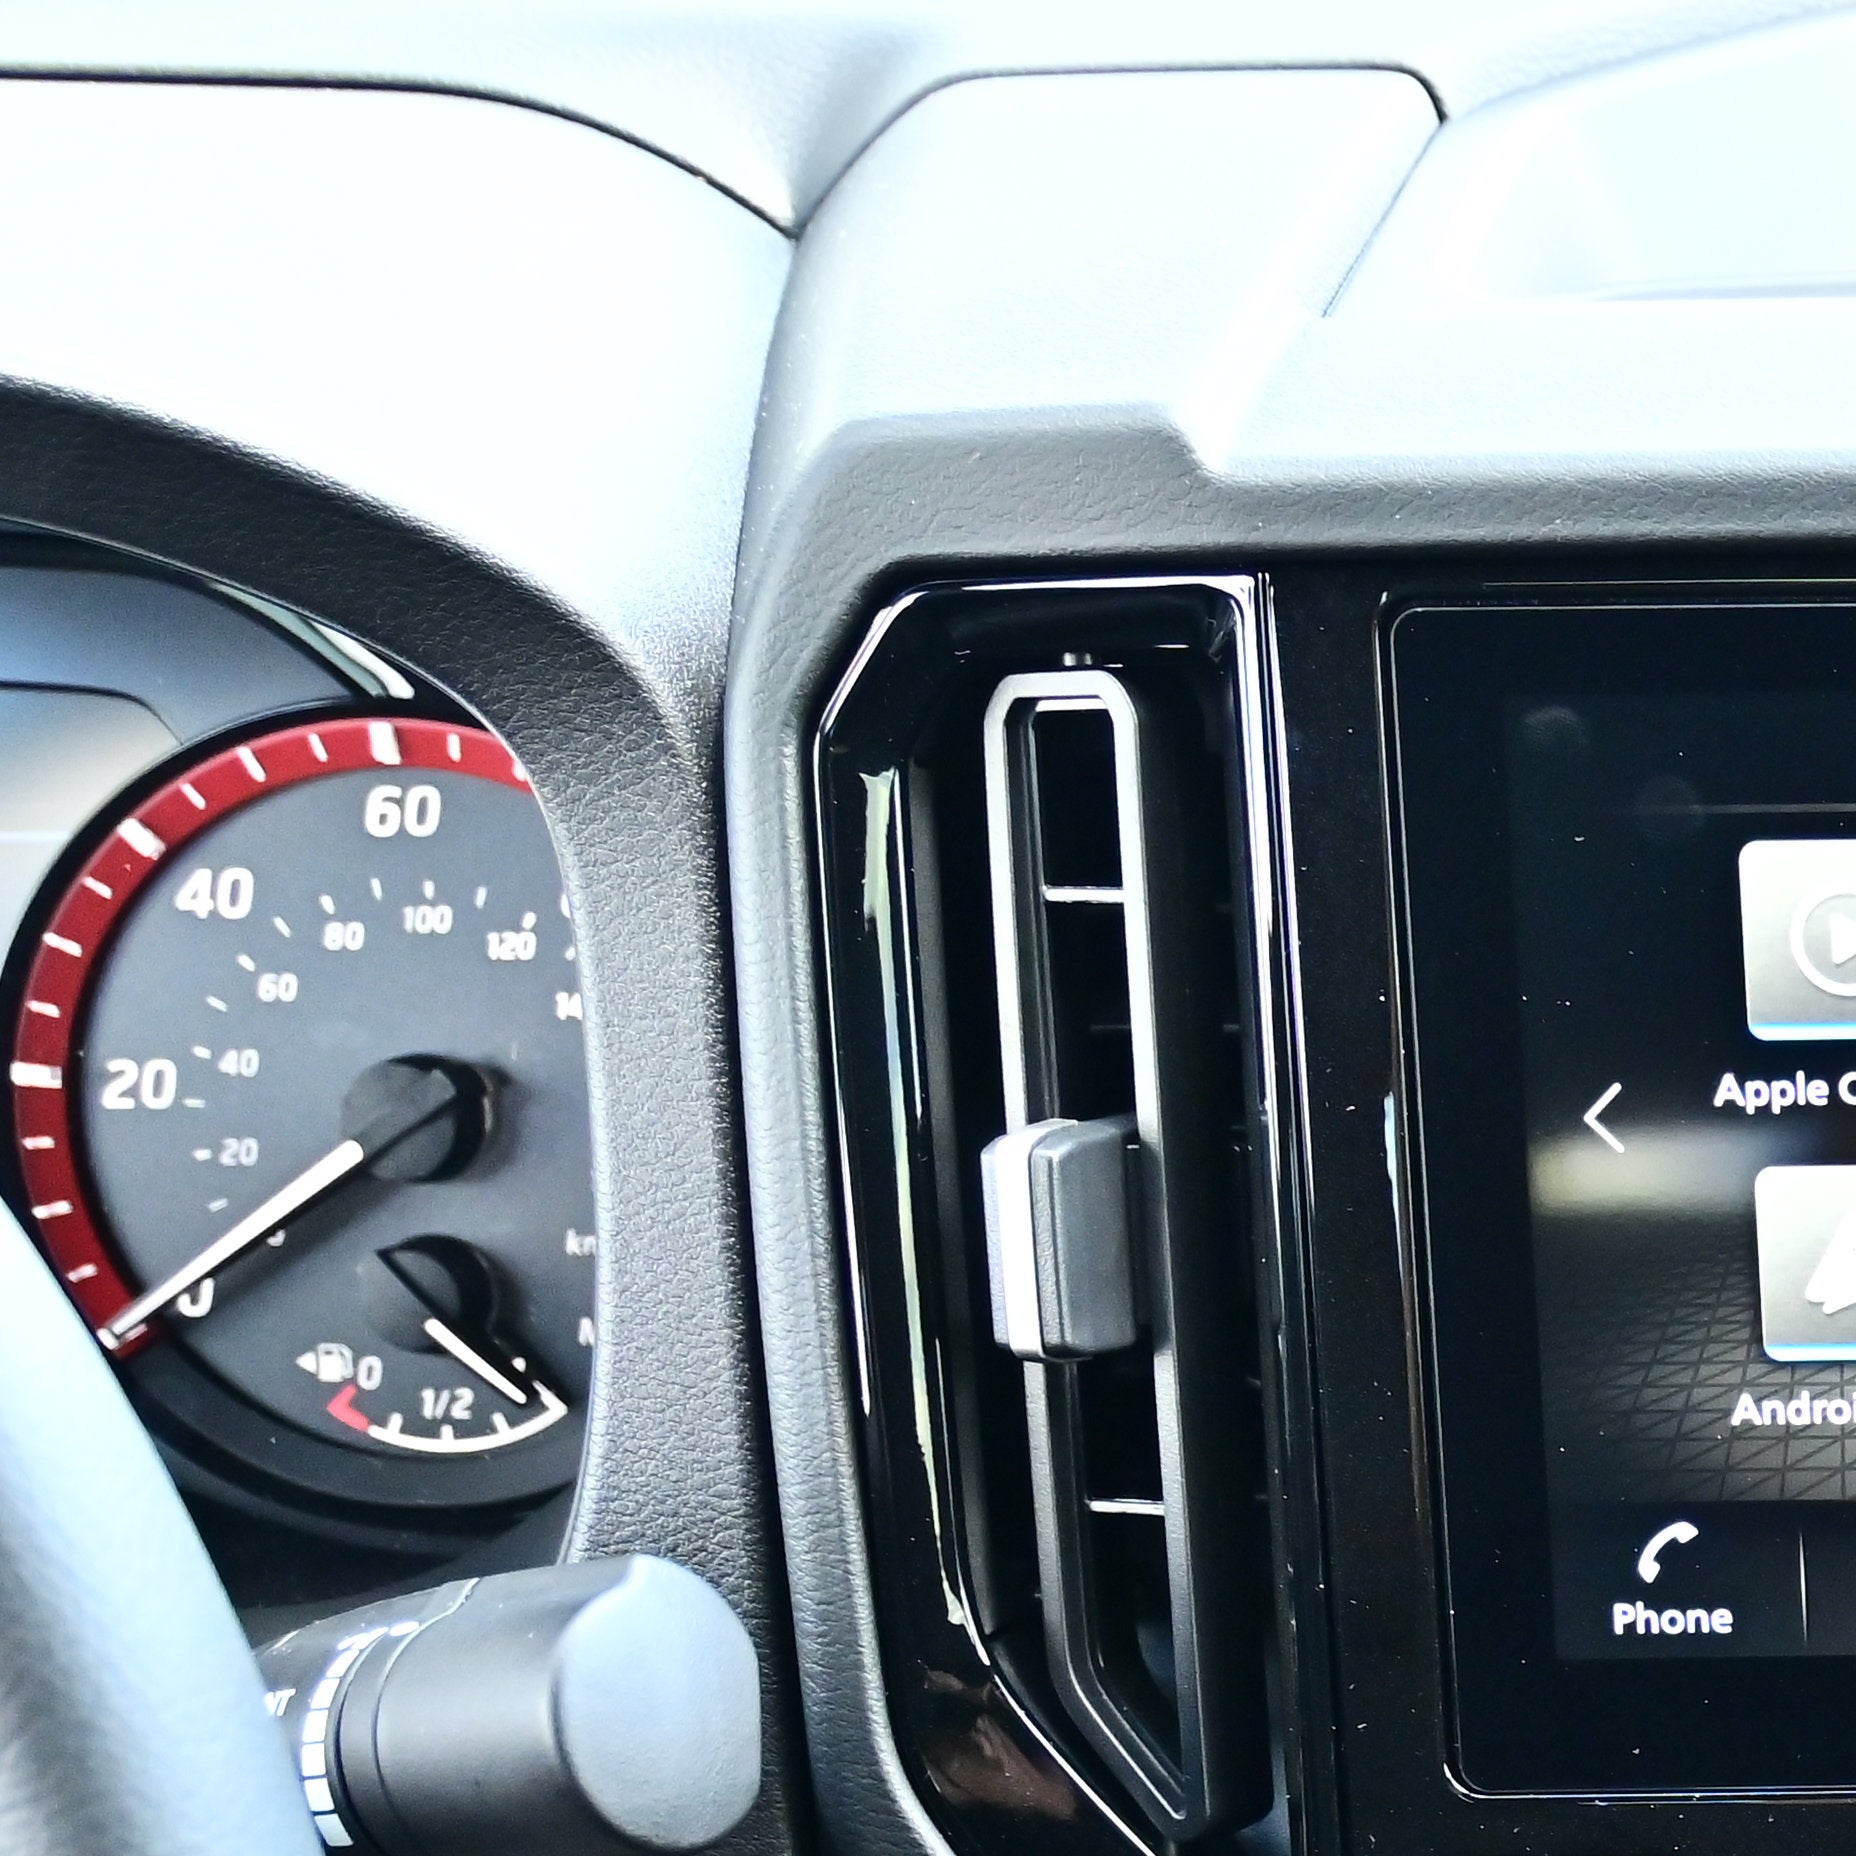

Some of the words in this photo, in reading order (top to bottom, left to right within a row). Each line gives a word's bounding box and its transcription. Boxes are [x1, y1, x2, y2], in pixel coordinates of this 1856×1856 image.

[364, 784, 442, 838] 60
[173, 866, 255, 920] 40
[402, 904, 453, 935] 100
[322, 921, 366, 951] 80
[487, 931, 537, 961] 120
[256, 972, 299, 1003] 60
[217, 1048, 260, 1078] 40
[100, 1057, 178, 1110] 20
[1713, 1069, 1830, 1116] Apple
[218, 1136, 259, 1167] 20
[420, 1386, 475, 1420] 1/2
[1612, 1600, 1734, 1635] Phone
